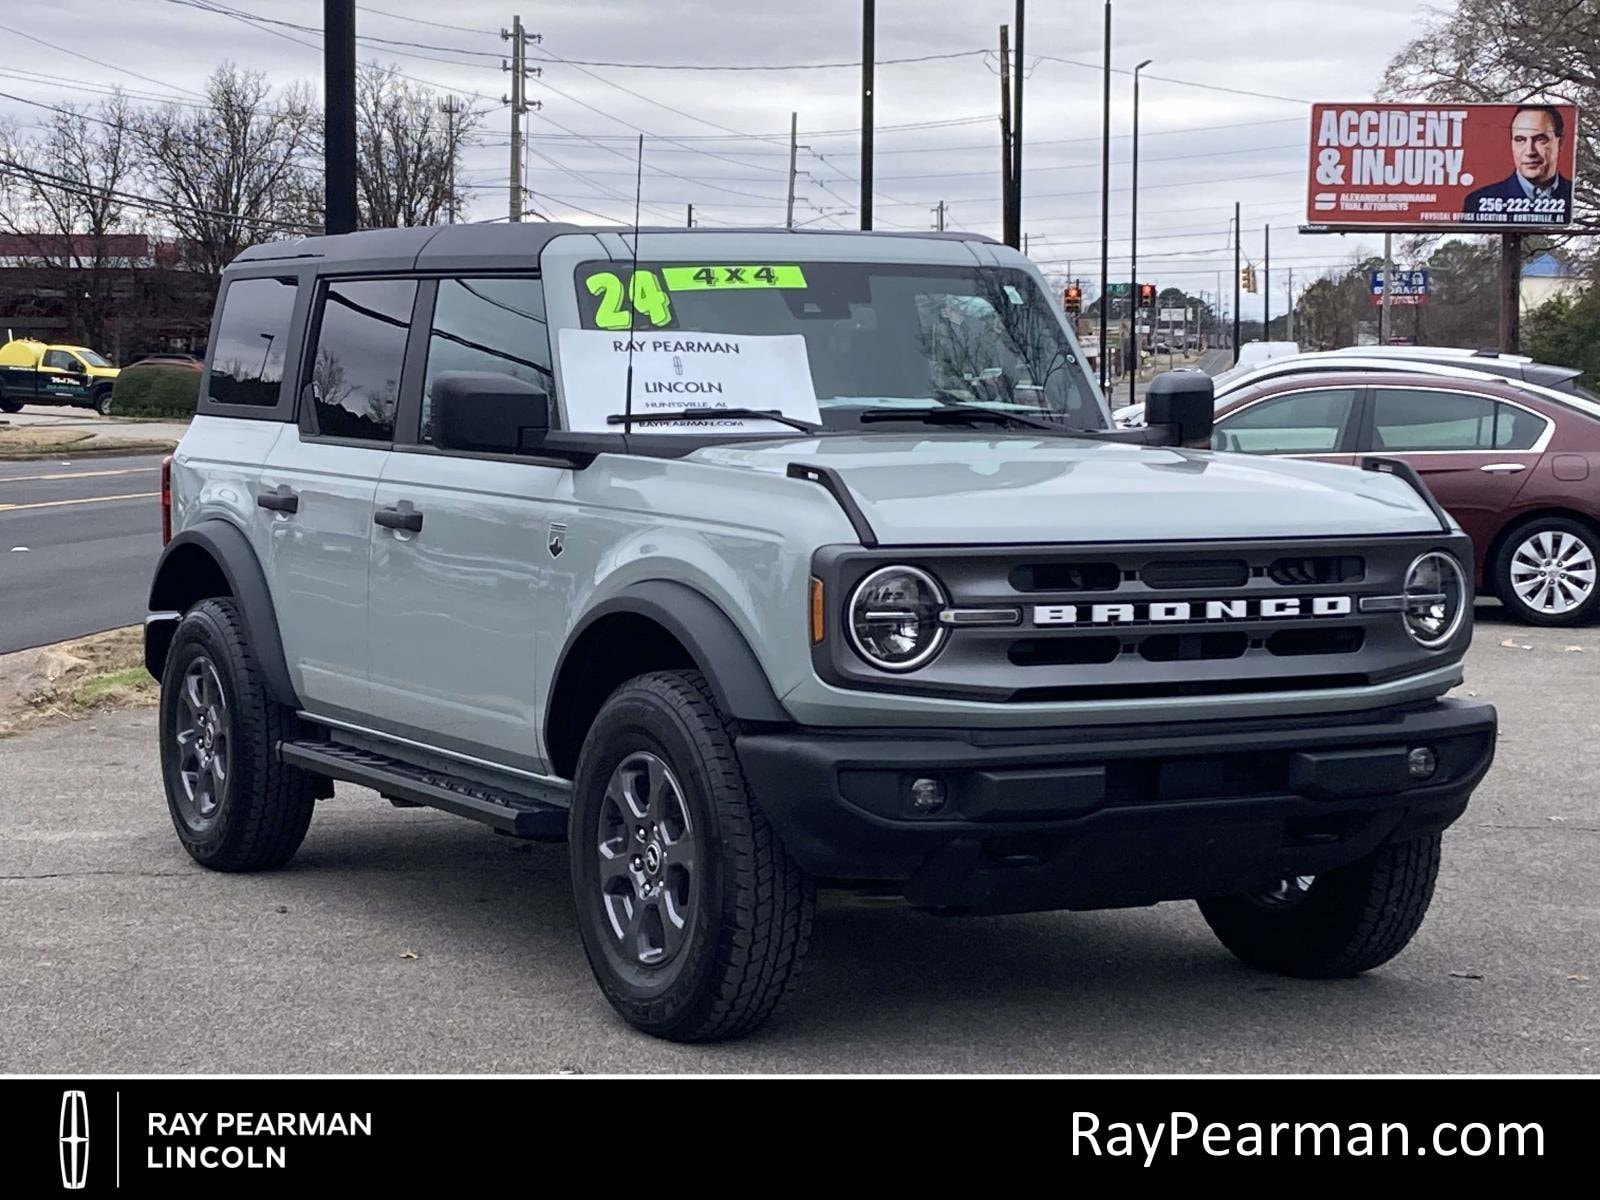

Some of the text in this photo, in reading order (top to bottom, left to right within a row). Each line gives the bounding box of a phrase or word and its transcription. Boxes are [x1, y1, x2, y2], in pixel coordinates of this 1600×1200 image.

[1318, 110, 1468, 147] ACCIDENT
[1315, 149, 1474, 187] & INJURY.
[1479, 197, 1566, 213] 256-222-2222
[586, 271, 671, 330] 24
[613, 341, 740, 354] RAY PEARMAN
[645, 382, 722, 393] LINCOLN
[1033, 596, 1352, 625] BRONCO
